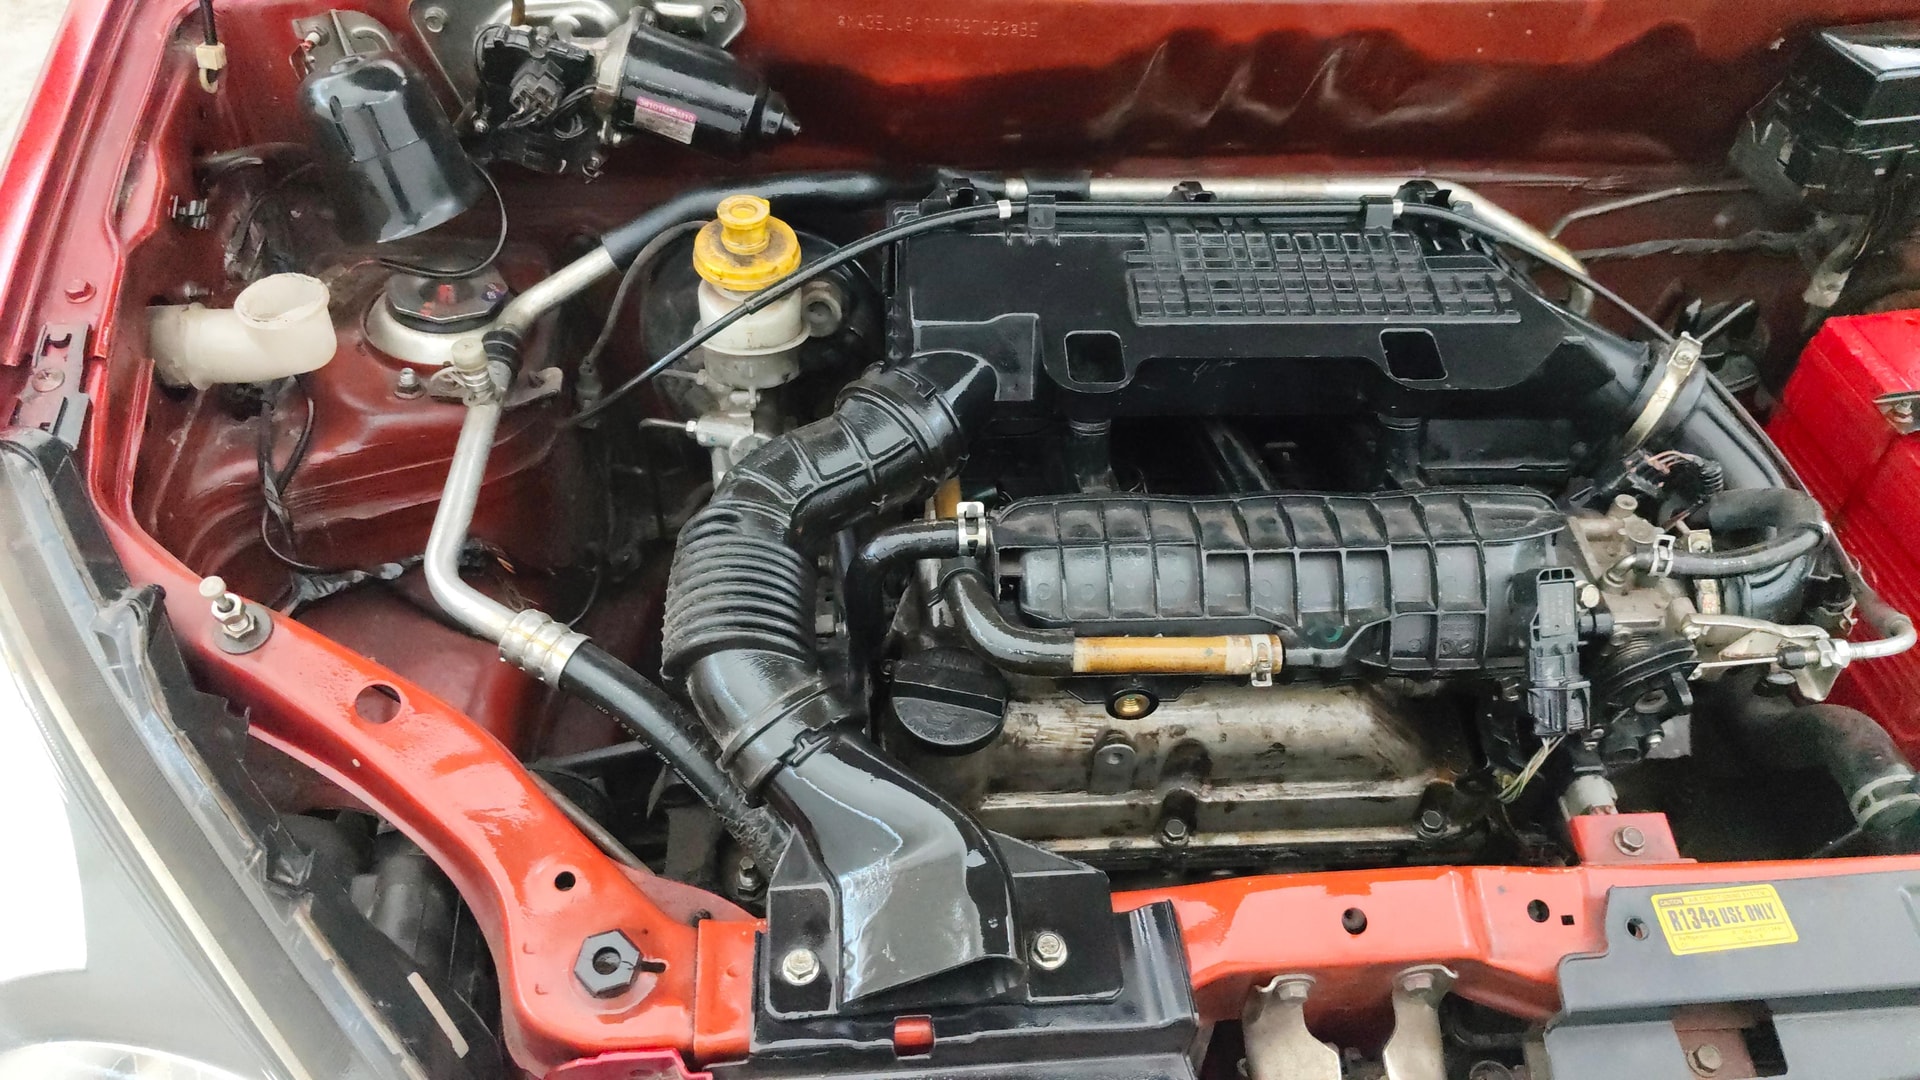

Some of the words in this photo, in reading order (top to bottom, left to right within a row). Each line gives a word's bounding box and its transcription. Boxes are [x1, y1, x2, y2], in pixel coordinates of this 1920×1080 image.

[1668, 907, 1721, 931] R134a
[1719, 906, 1745, 924] USE
[1745, 903, 1777, 921] ONLY
